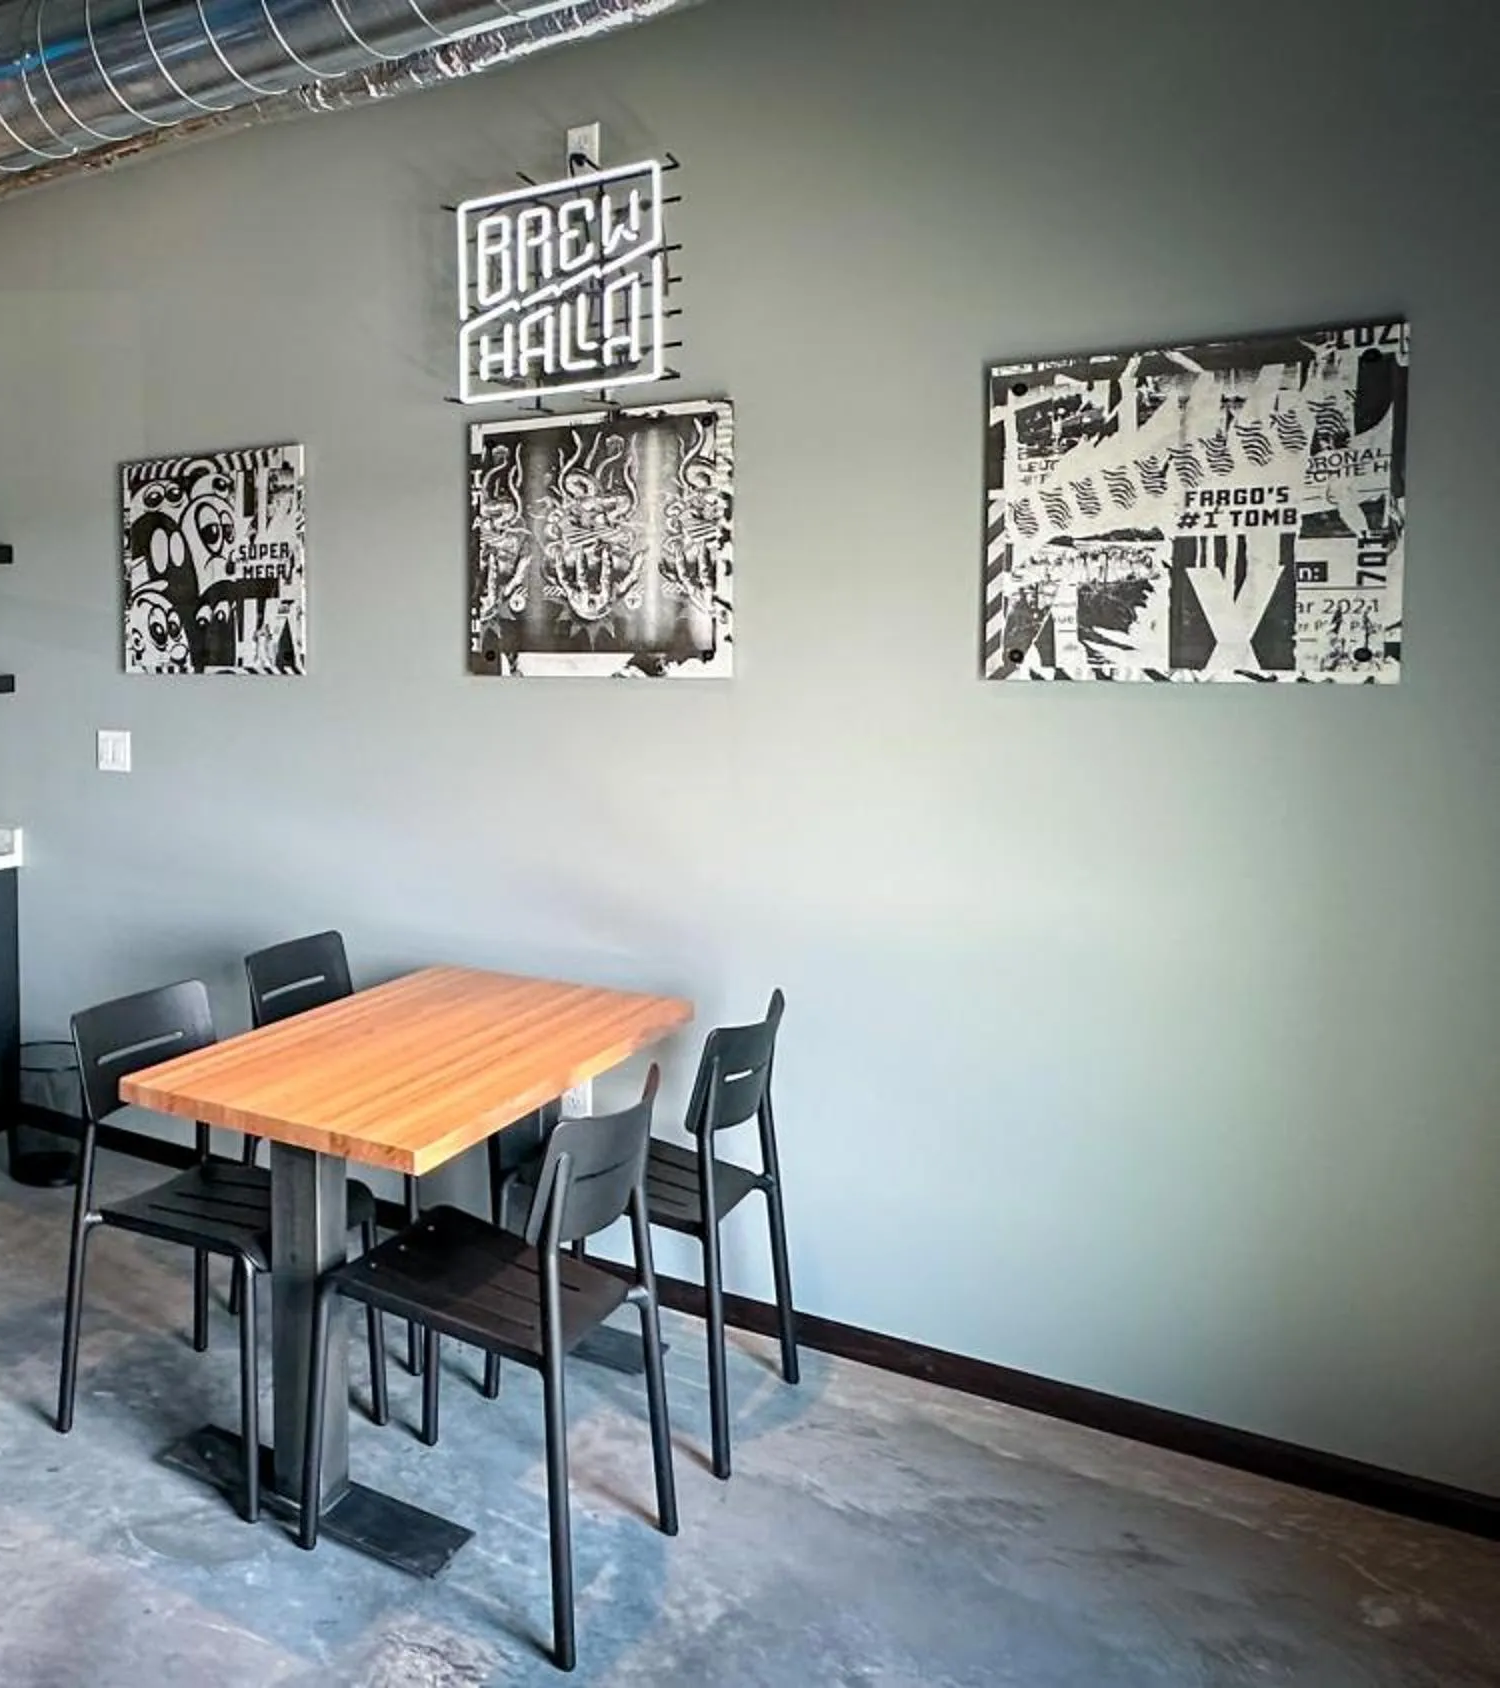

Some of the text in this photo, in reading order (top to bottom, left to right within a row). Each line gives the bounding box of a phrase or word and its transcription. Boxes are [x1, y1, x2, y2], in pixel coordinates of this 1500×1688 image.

[477, 188, 640, 306] BREW
[479, 272, 642, 382] HALLA
[1184, 485, 1290, 507] FARGO'S
[1229, 507, 1297, 527] TOMB
[238, 541, 290, 563] SUPER
